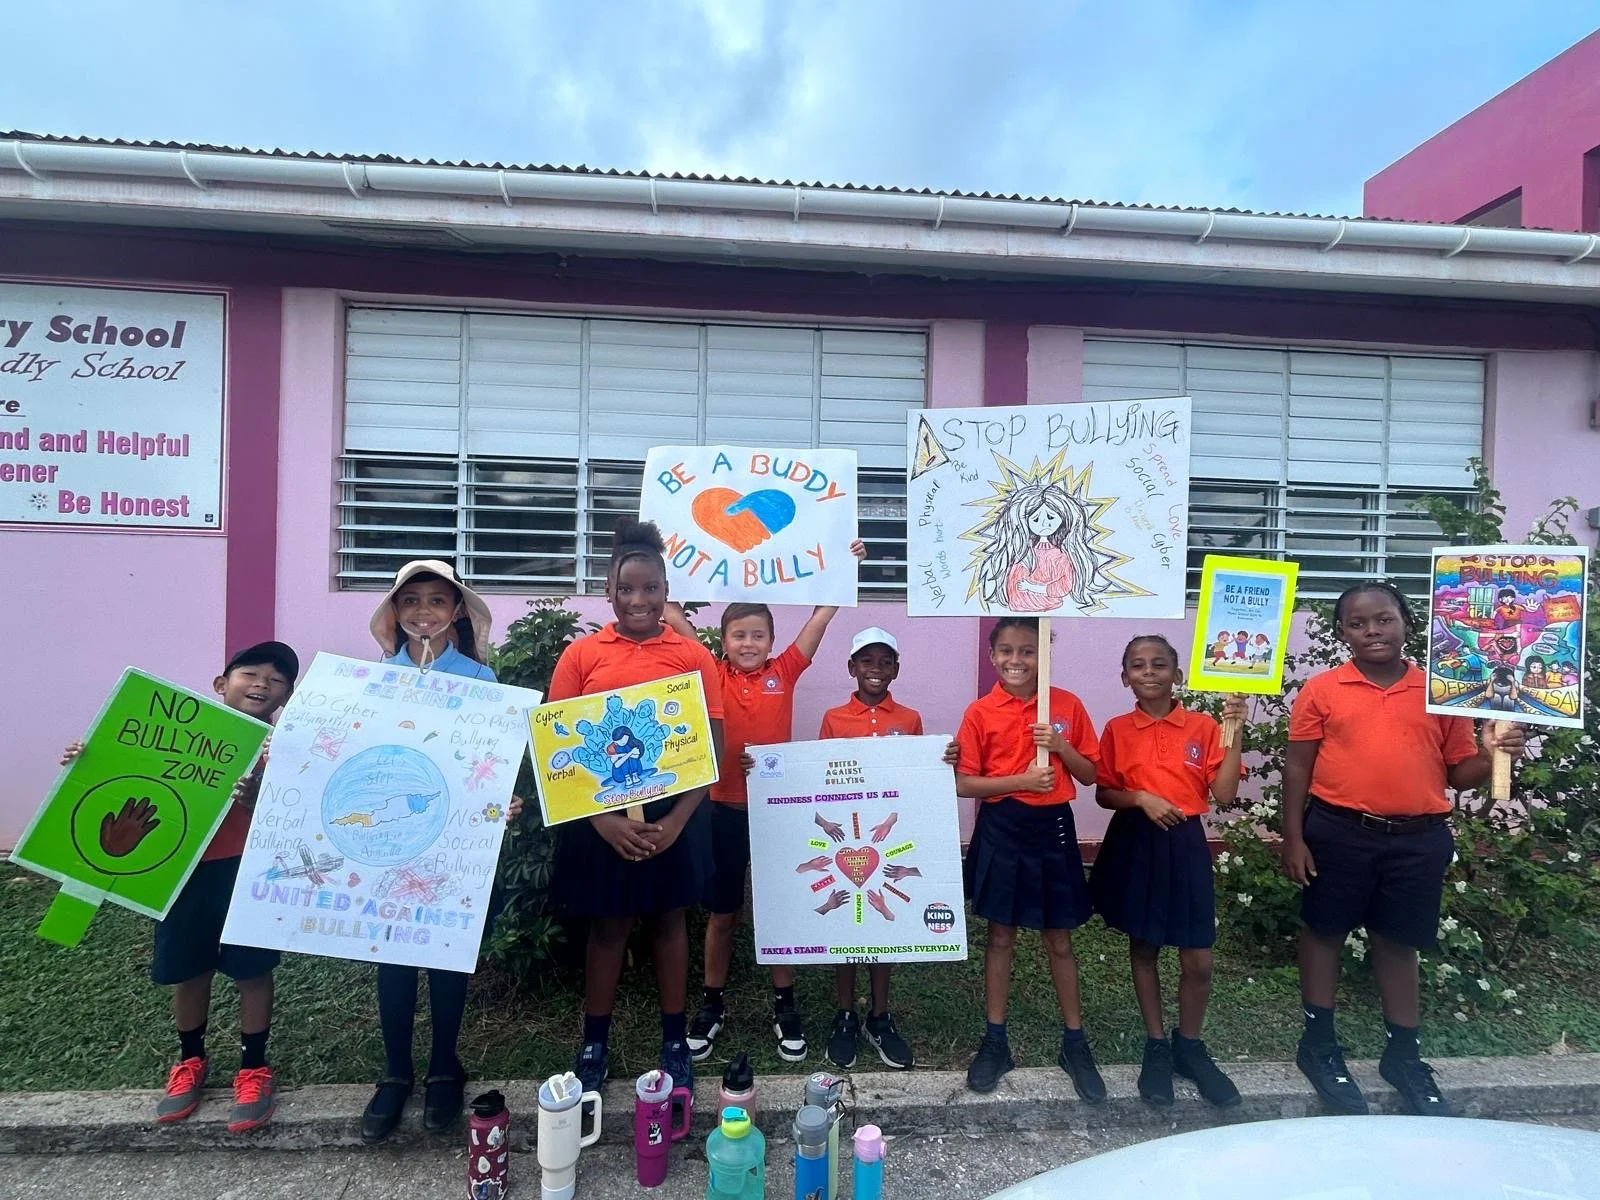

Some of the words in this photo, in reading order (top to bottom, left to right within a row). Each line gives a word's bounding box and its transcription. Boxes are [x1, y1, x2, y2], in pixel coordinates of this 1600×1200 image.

[46, 315, 187, 349] School
[71, 352, 186, 382] School
[39, 430, 88, 453] and
[97, 430, 190, 460] Helpful
[943, 415, 1026, 455] STOP
[0, 463, 58, 484] ener
[657, 462, 696, 495] BE
[712, 452, 733, 475] A
[750, 454, 846, 502] BUDDY
[58, 490, 91, 514] Be
[101, 492, 190, 518] Honest
[664, 533, 712, 577] NOT
[708, 558, 729, 587] A
[743, 543, 826, 588] BULLY
[1485, 554, 1537, 568] STOP
[1223, 594, 1239, 603] NOT
[1241, 596, 1246, 604] A
[1247, 596, 1269, 606] BULLY
[1225, 585, 1235, 593] BE
[1237, 586, 1242, 594] A
[1244, 586, 1270, 596] FRIEND
[667, 680, 691, 694] Social
[149, 690, 200, 724] NO
[535, 709, 564, 727] Cyber
[117, 719, 239, 764] BULLYING
[665, 733, 698, 752] Physical
[161, 760, 225, 789] ZONE
[546, 767, 576, 782] Verbal
[259, 782, 301, 807] NO
[767, 796, 812, 805] KINDNESS
[815, 792, 863, 802] CONNECTS
[882, 790, 899, 798] ALL
[811, 840, 827, 848] LOVE
[251, 881, 350, 912] UNITED
[361, 899, 475, 929] AGAINST
[927, 912, 952, 920] KIND
[301, 916, 431, 945] BULLYING
[928, 922, 952, 931] NESS
[761, 947, 784, 955] TAKE
[829, 946, 866, 954] CHOOSE
[867, 945, 912, 953] KINDNESS
[914, 944, 961, 953] EVERYDAY
